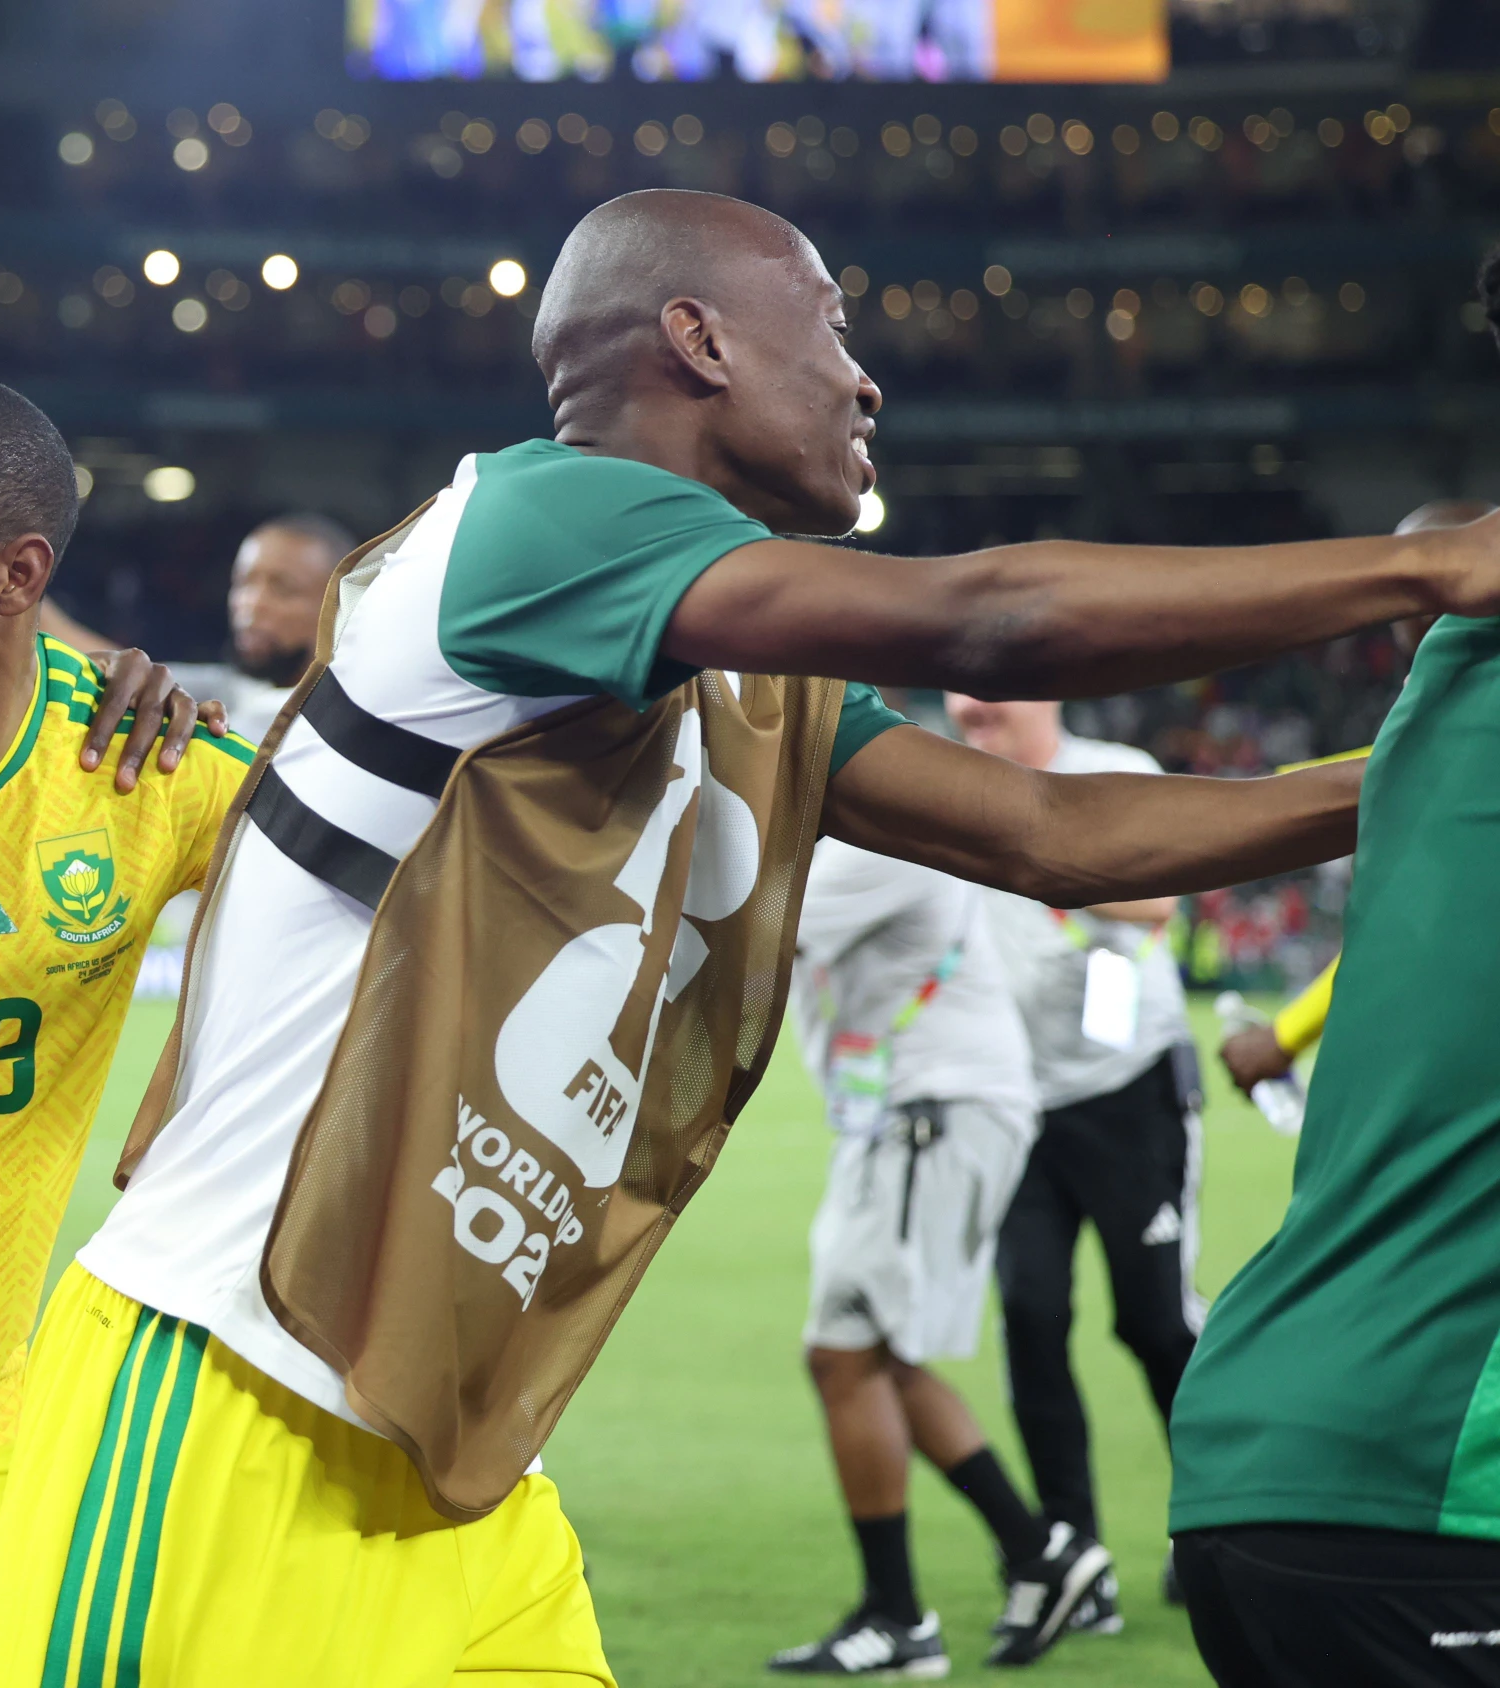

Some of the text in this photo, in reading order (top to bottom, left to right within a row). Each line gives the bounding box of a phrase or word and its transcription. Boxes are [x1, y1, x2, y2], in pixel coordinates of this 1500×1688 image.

[60, 920, 121, 942] SOUTH AFRICA
[46, 964, 66, 975] SOUTH
[67, 960, 90, 971] AFRICA
[562, 1057, 628, 1145] FIFA
[457, 1093, 570, 1222] WORLD
